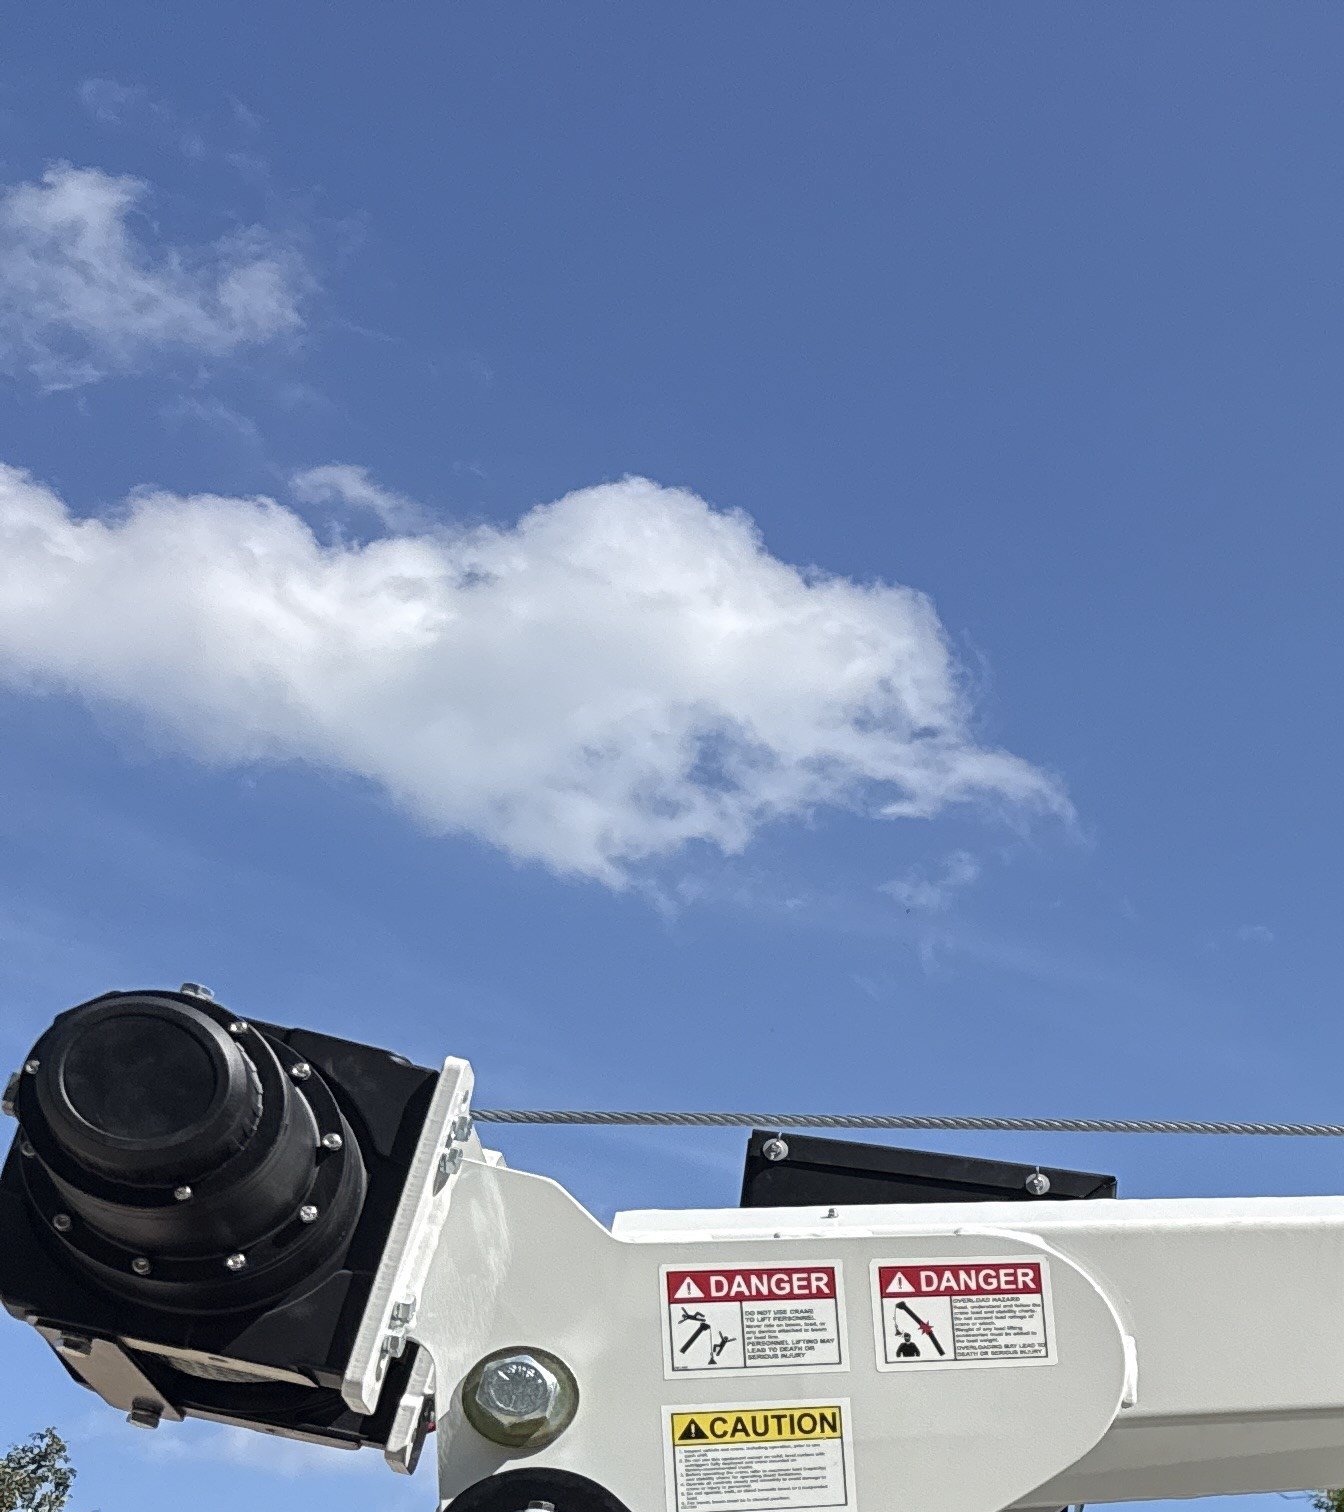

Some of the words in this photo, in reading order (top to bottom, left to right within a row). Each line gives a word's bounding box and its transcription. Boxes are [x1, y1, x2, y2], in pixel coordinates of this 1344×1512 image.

[710, 1273, 830, 1297] DANGER
[920, 1268, 1036, 1292] DANGER
[709, 1412, 838, 1440] CAUTION
